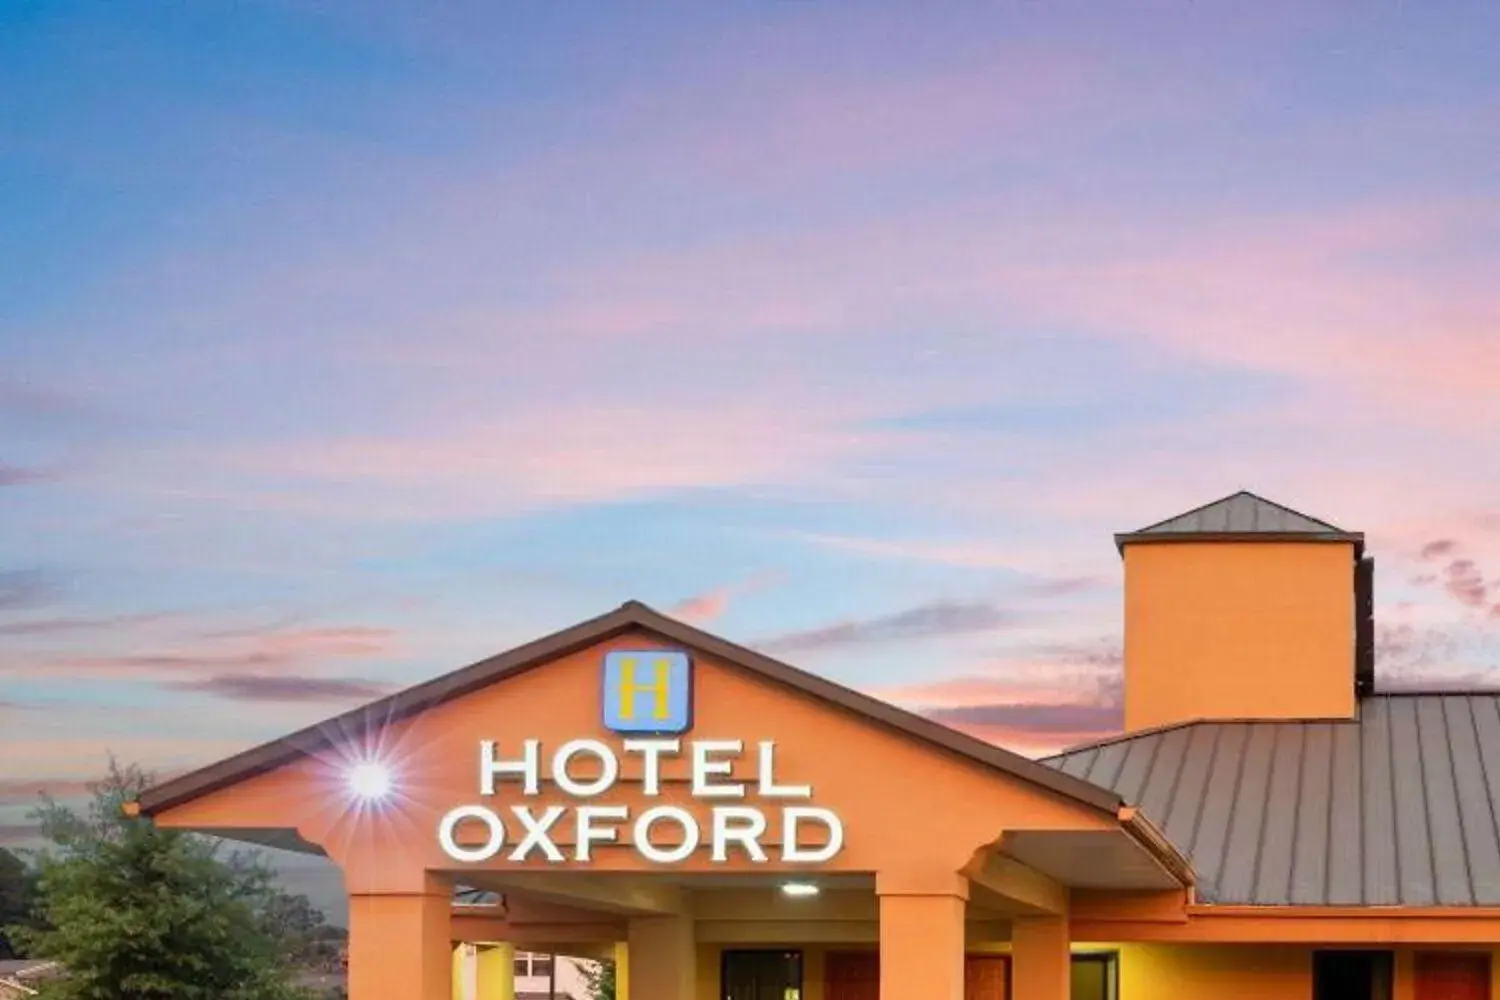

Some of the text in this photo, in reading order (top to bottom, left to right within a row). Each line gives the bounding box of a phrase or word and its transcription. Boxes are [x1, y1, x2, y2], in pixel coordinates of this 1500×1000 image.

[618, 658, 671, 720] H
[480, 738, 812, 798] HOTEL
[438, 805, 844, 862] OXFORD
